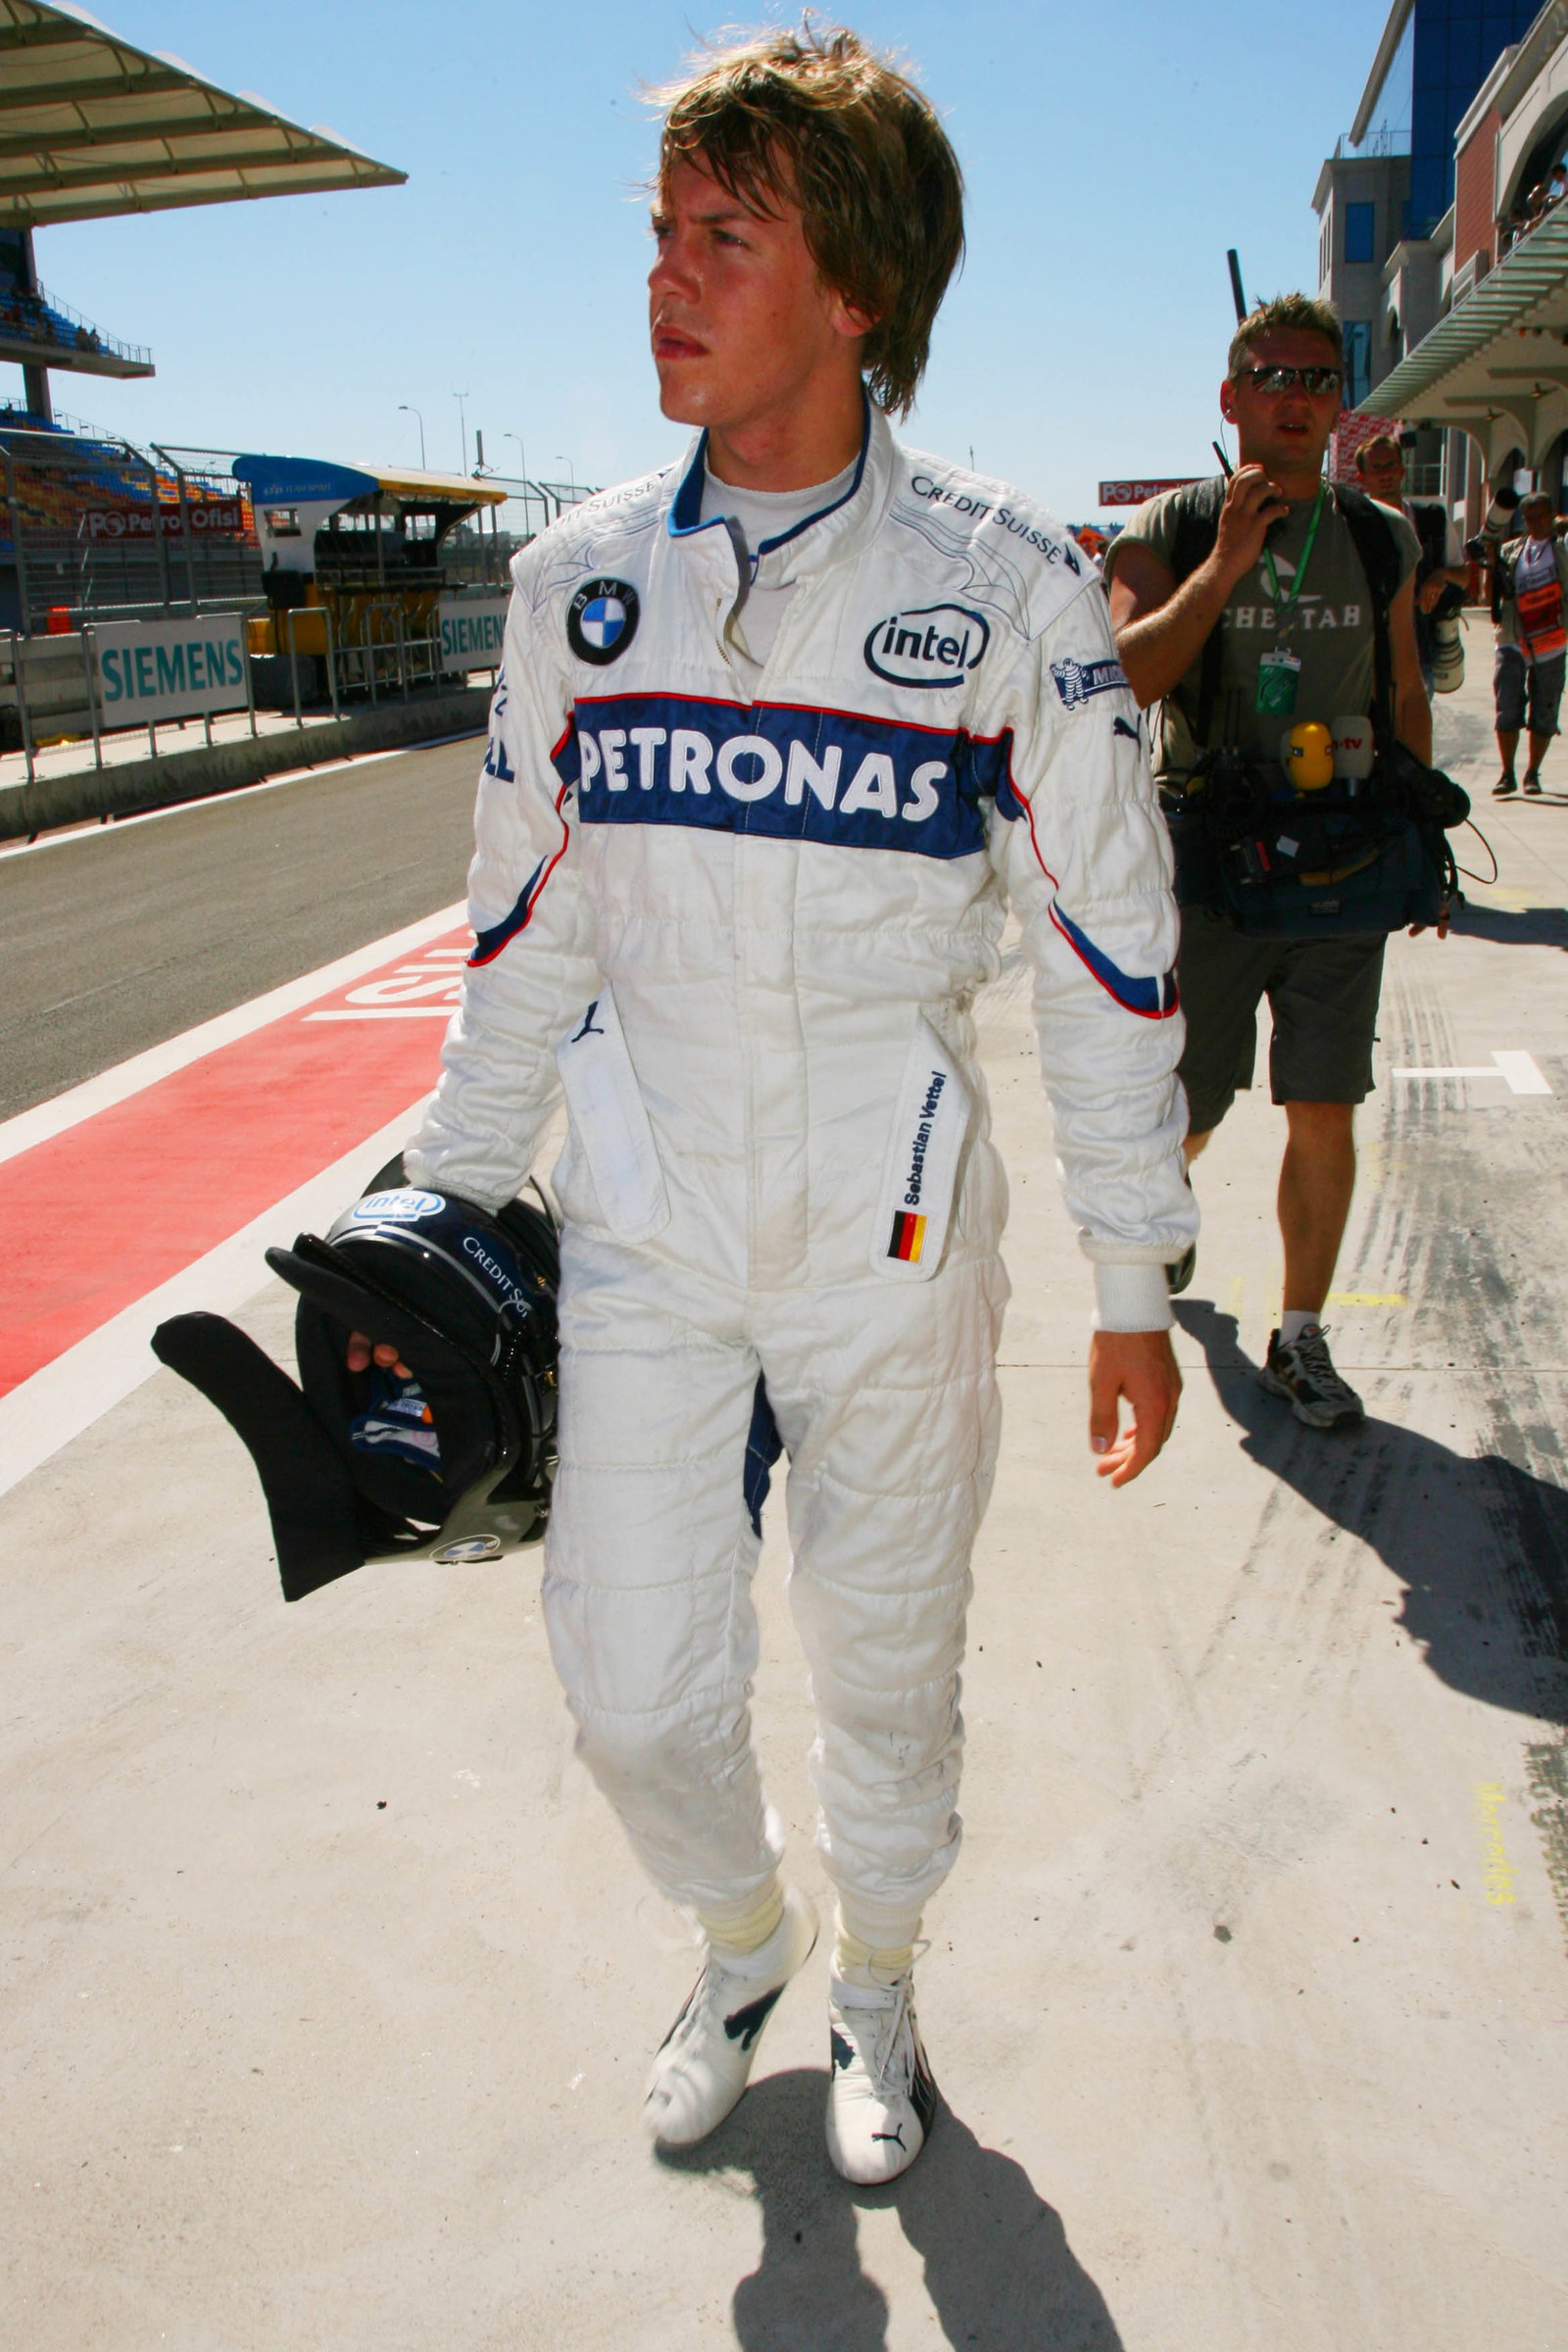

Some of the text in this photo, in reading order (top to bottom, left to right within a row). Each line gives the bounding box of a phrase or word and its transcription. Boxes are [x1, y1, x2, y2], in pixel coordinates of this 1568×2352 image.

[588, 478, 657, 513] SUISSE
[911, 475, 1062, 564] CREDIT SUISSE
[441, 612, 509, 657] SIEMEN
[882, 615, 970, 668] intel
[1222, 605, 1360, 630] CHETAH
[101, 638, 243, 702] SIEMENS
[577, 726, 949, 823] PETRONAS
[904, 1070, 948, 1206] Sebastian Vettel
[463, 1236, 514, 1292] CREDIT
[1473, 1782, 1521, 1905] Mercedes
